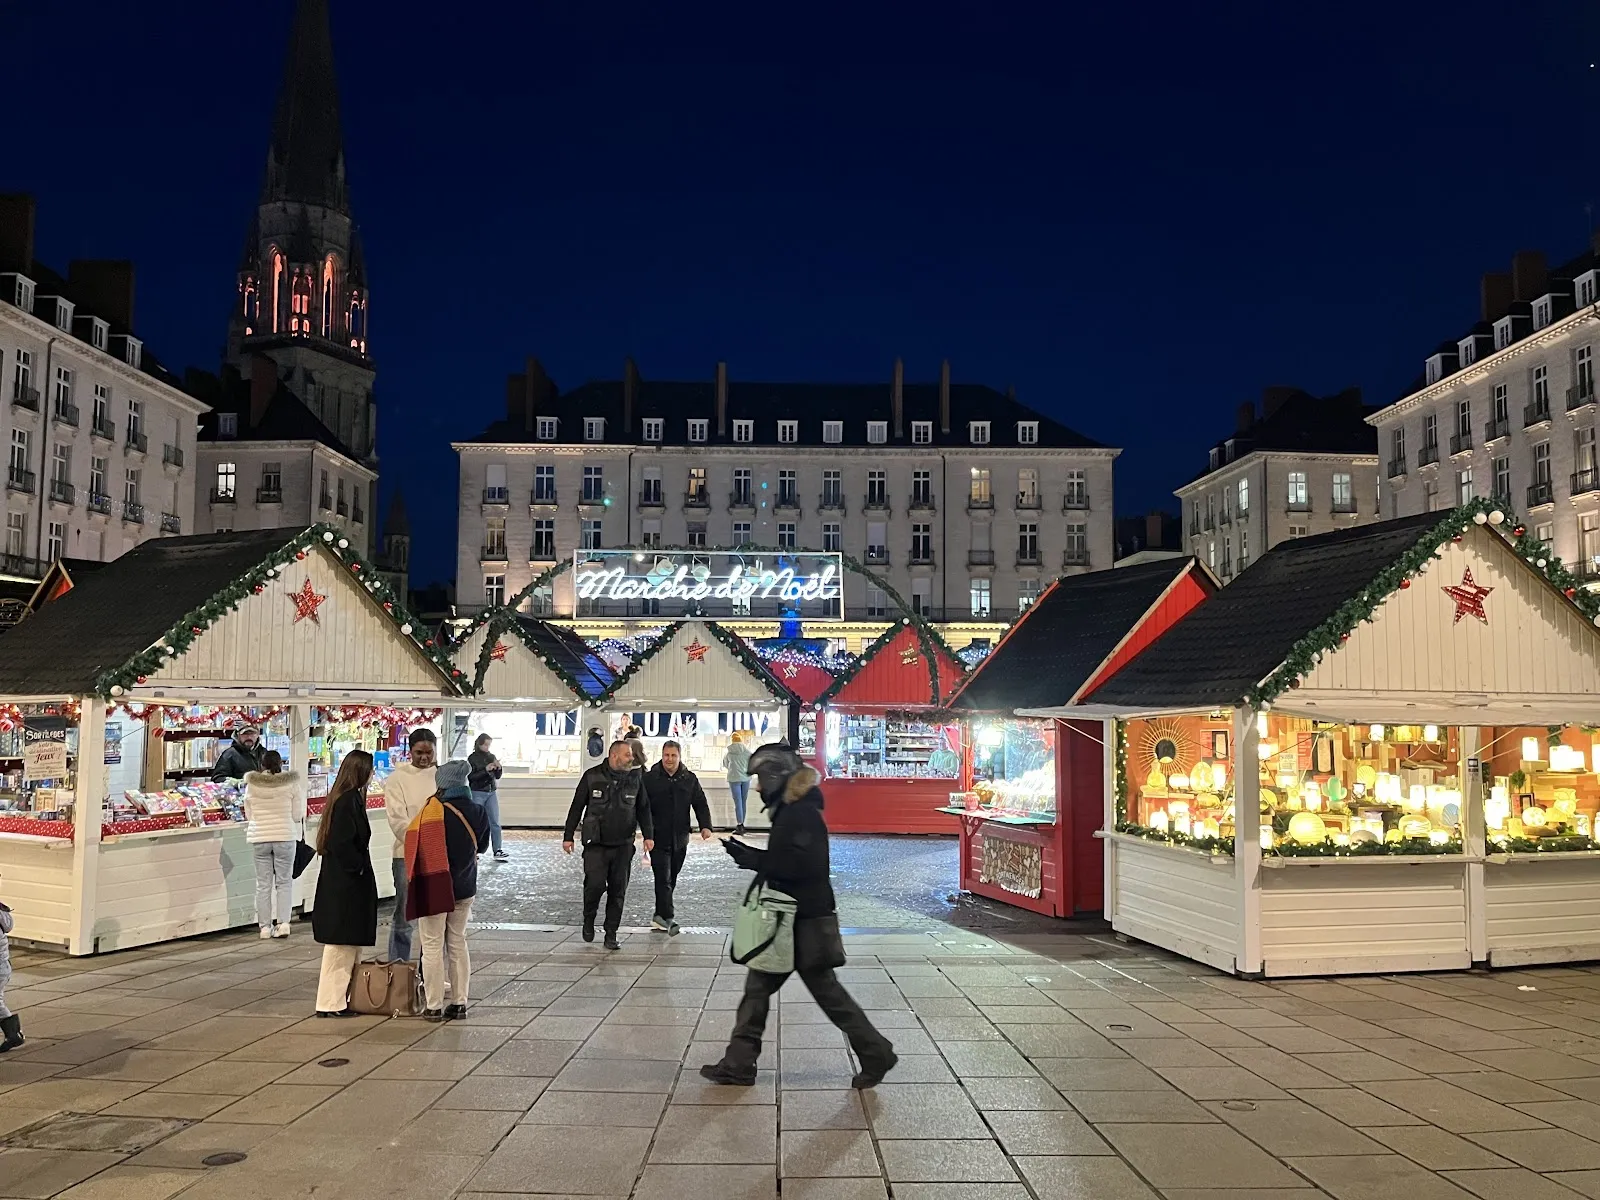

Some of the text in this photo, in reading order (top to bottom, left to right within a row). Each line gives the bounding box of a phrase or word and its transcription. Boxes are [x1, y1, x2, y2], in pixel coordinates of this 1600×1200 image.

[576, 564, 838, 601] Marché de Noël
